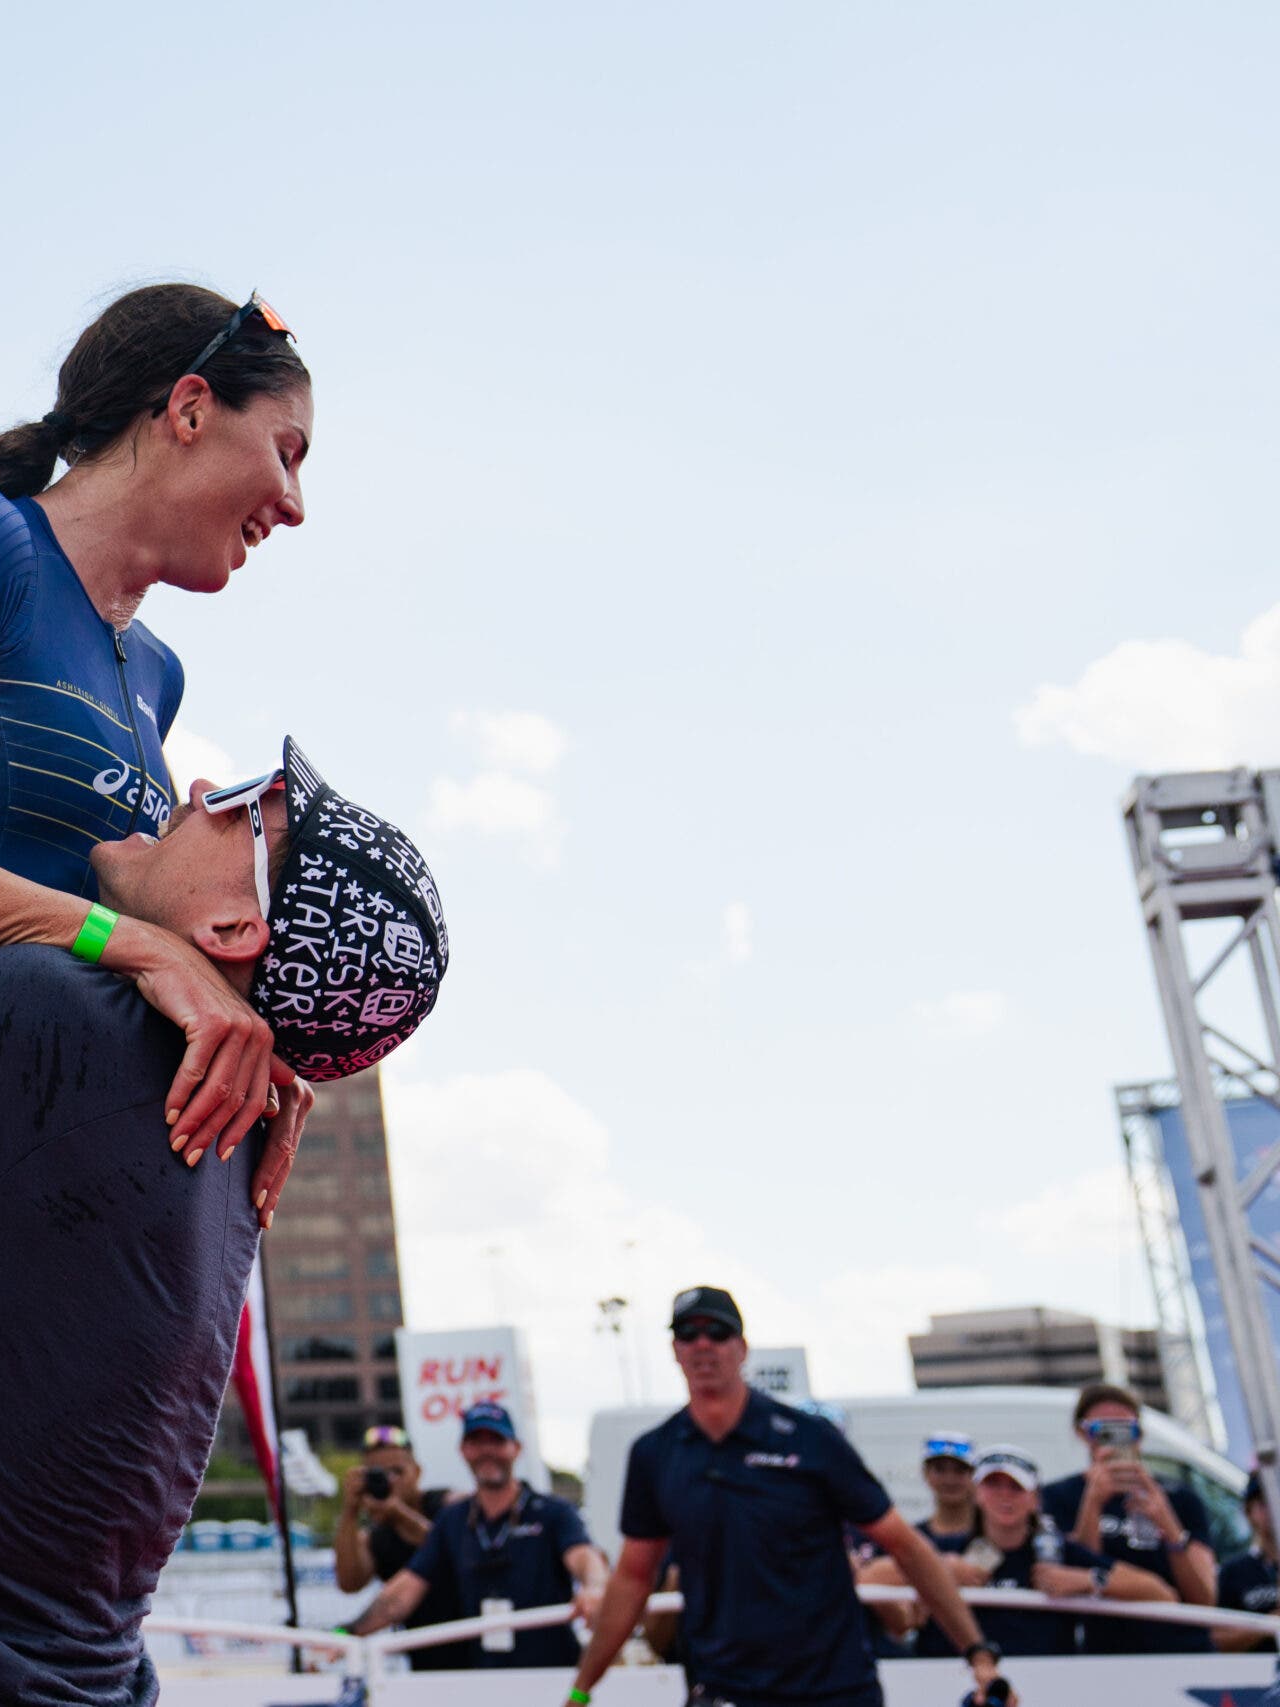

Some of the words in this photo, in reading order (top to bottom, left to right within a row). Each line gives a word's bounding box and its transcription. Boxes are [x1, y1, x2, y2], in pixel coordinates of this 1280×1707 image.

[126, 777, 171, 836] asic
[323, 907, 380, 1011] RISK
[418, 1354, 504, 1386] RUN
